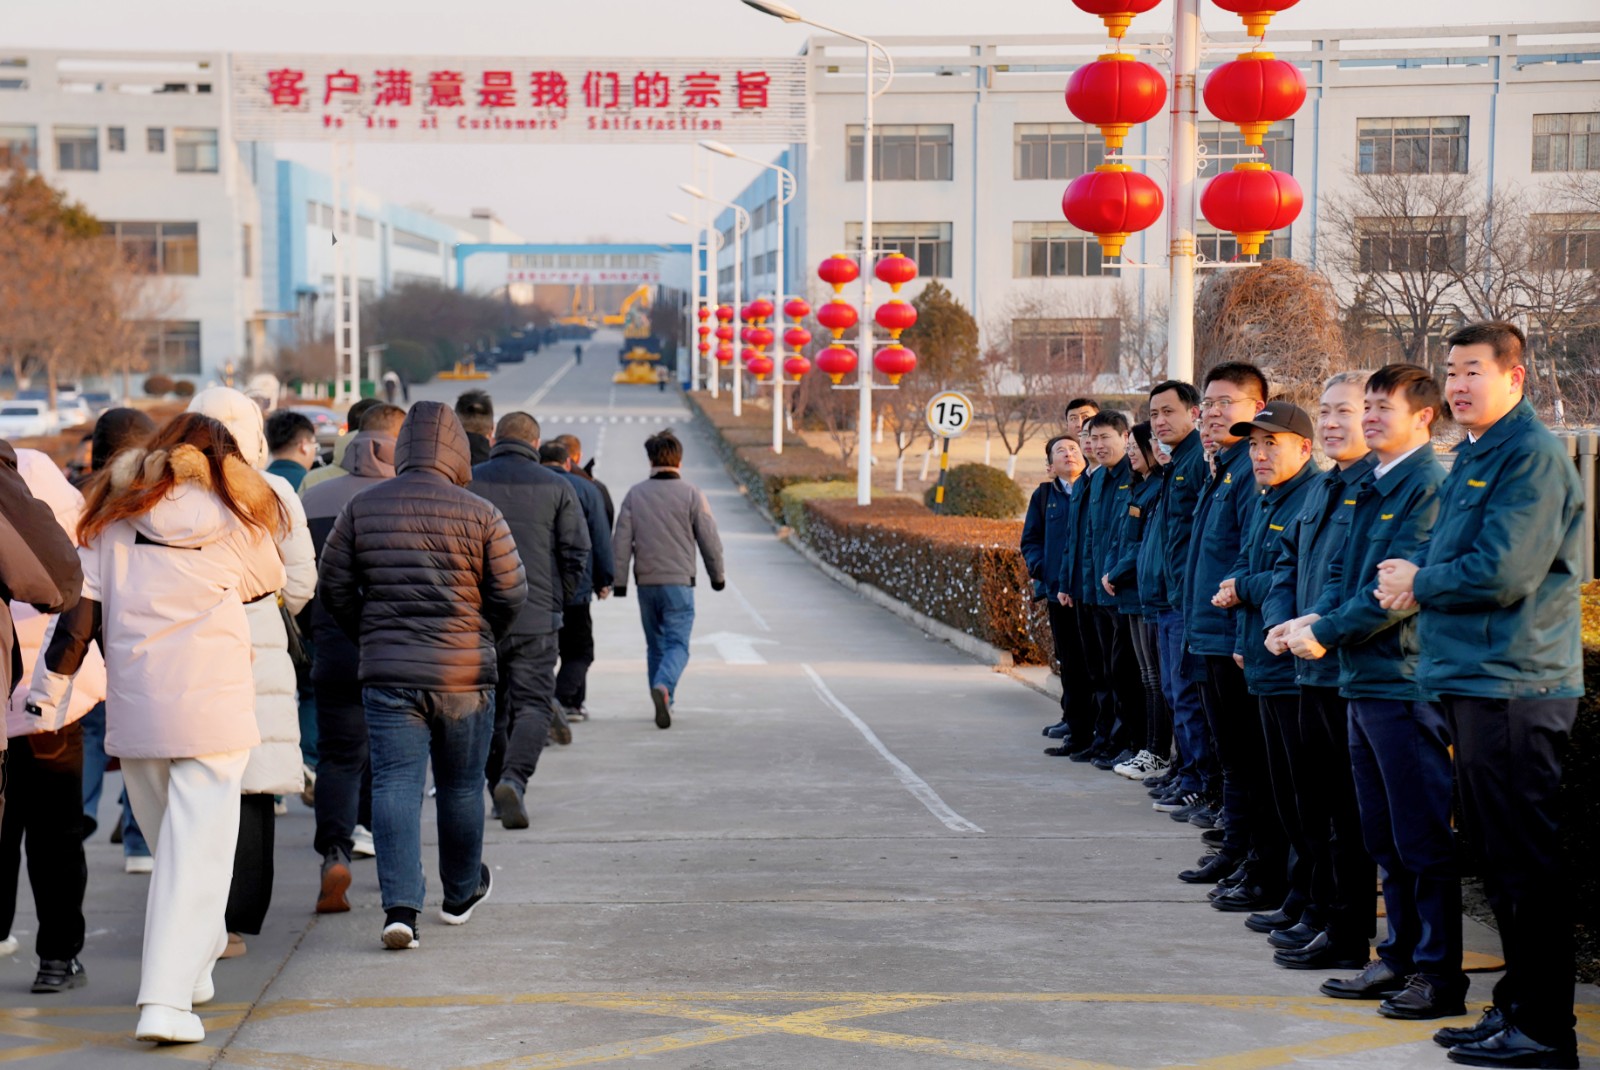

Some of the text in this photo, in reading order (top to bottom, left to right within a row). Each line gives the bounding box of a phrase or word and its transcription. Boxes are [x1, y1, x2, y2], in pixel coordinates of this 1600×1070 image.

[266, 67, 772, 109] 客户满意是我们的宗旨
[322, 114, 344, 128] We
[587, 115, 722, 130] Satisfaction
[936, 402, 964, 427] 15
